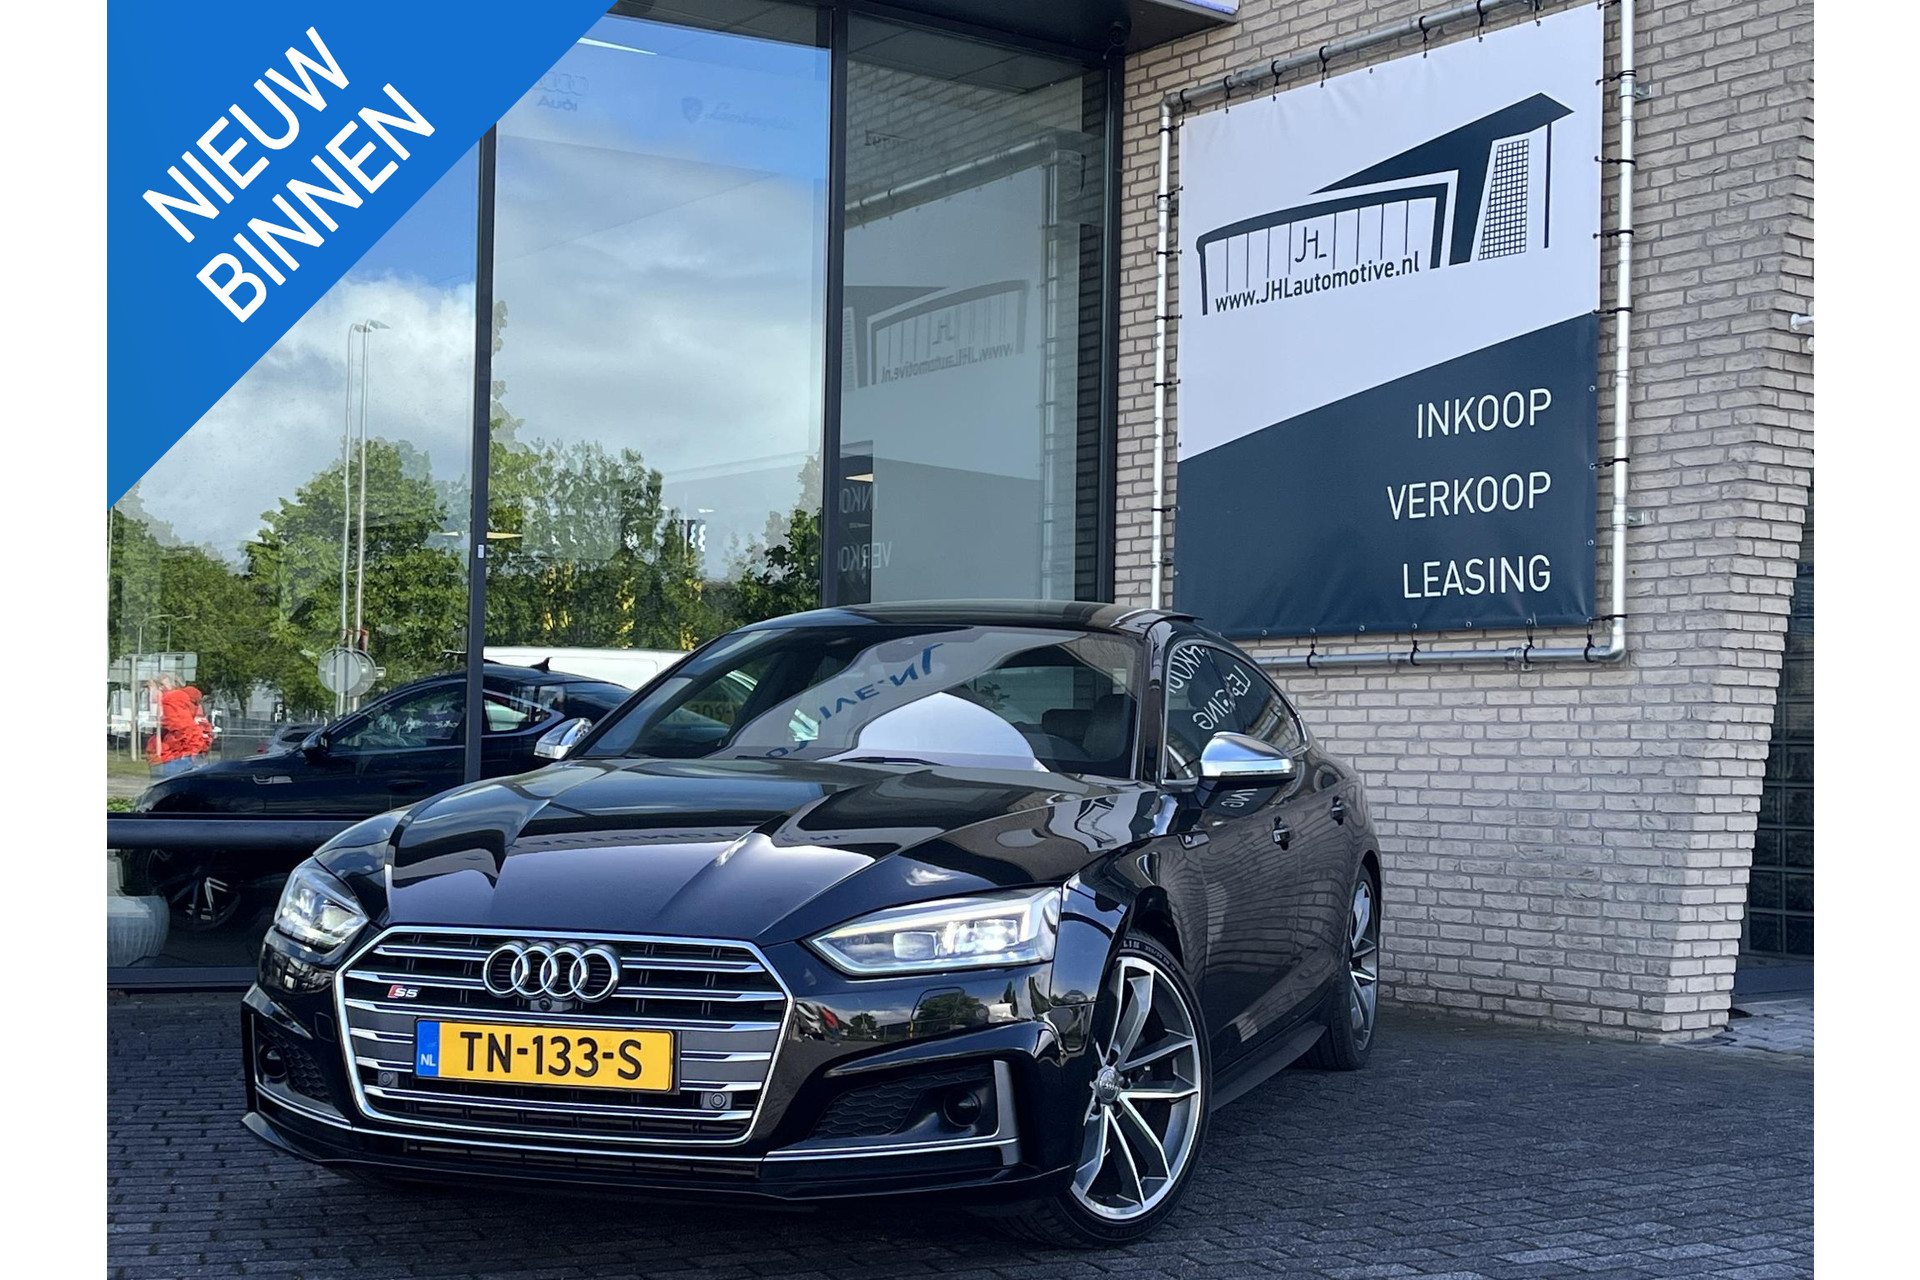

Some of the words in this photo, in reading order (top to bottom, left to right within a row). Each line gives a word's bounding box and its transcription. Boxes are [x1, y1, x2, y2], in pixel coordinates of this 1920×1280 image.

[1215, 251, 1420, 313] www.JHLautomotive.nl
[1416, 388, 1552, 439] INKOOP
[1387, 471, 1551, 520] VERKOOP
[1402, 555, 1550, 599] LEASING
[392, 987, 420, 998] S5
[420, 1055, 436, 1067] NL
[460, 1031, 642, 1080] TN-133-S
